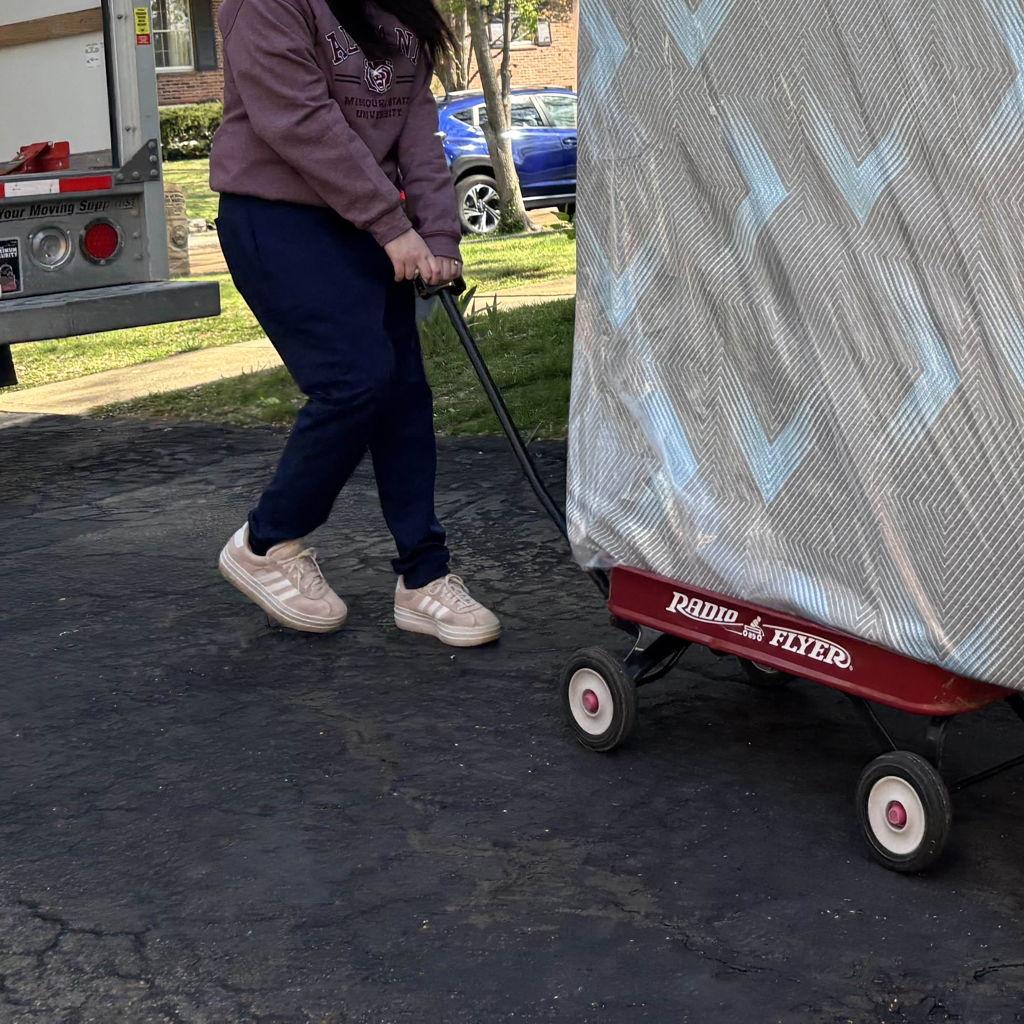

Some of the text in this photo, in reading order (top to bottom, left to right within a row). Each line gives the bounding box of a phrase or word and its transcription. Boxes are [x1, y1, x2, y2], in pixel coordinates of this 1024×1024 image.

[0, 207, 25, 220] Your
[29, 203, 75, 216] Moving
[665, 590, 739, 623] RADIO
[768, 628, 852, 669] FLYER
